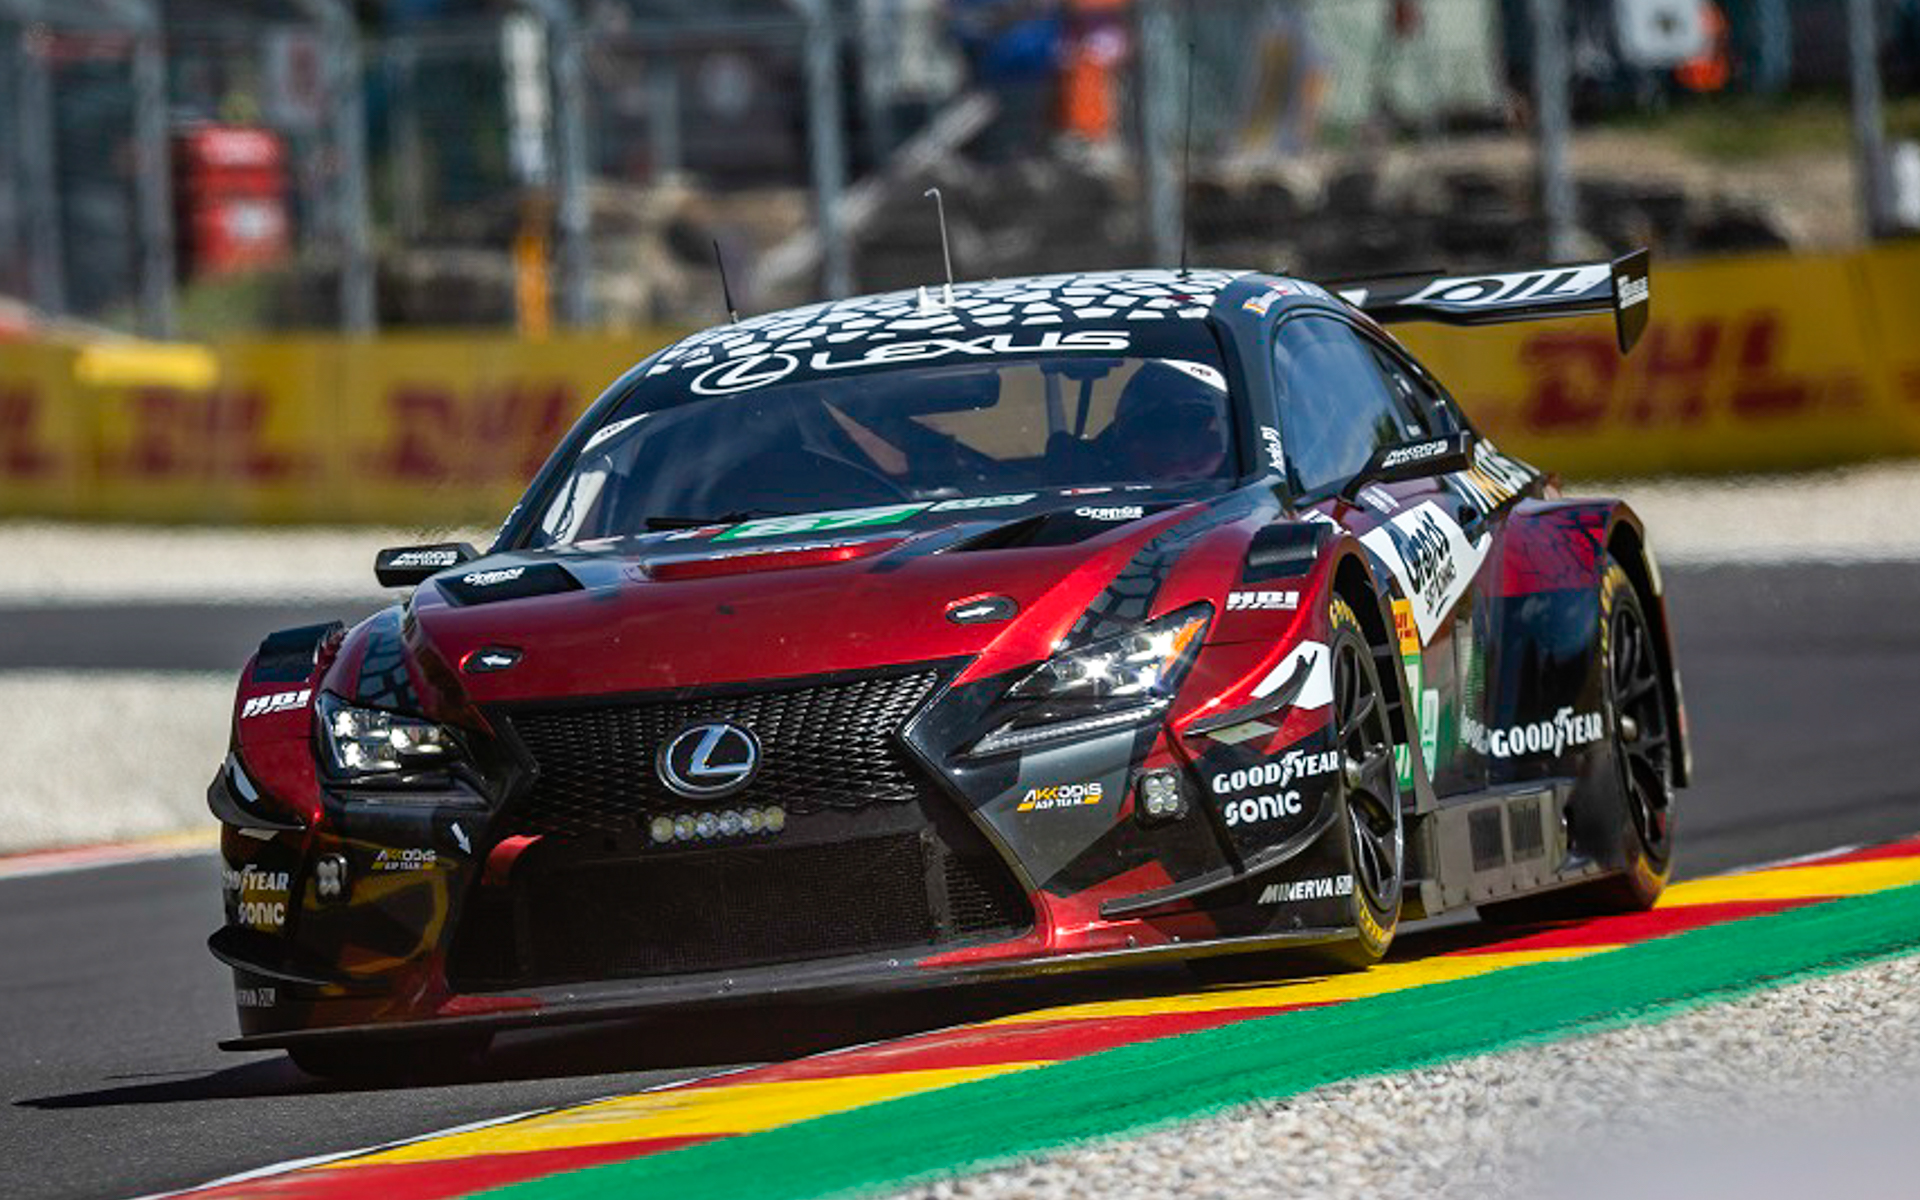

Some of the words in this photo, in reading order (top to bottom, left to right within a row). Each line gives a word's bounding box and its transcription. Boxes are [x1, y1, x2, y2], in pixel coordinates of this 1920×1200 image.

[810, 331, 1131, 370] LEXUS
[1521, 308, 1812, 432] DHL
[1491, 705, 1604, 758] GOODYEAR
[1212, 750, 1340, 793] GOODYEAR
[1224, 790, 1302, 827] SONIC
[1258, 877, 1334, 904] MINERVA
[238, 902, 285, 925] SONIC
